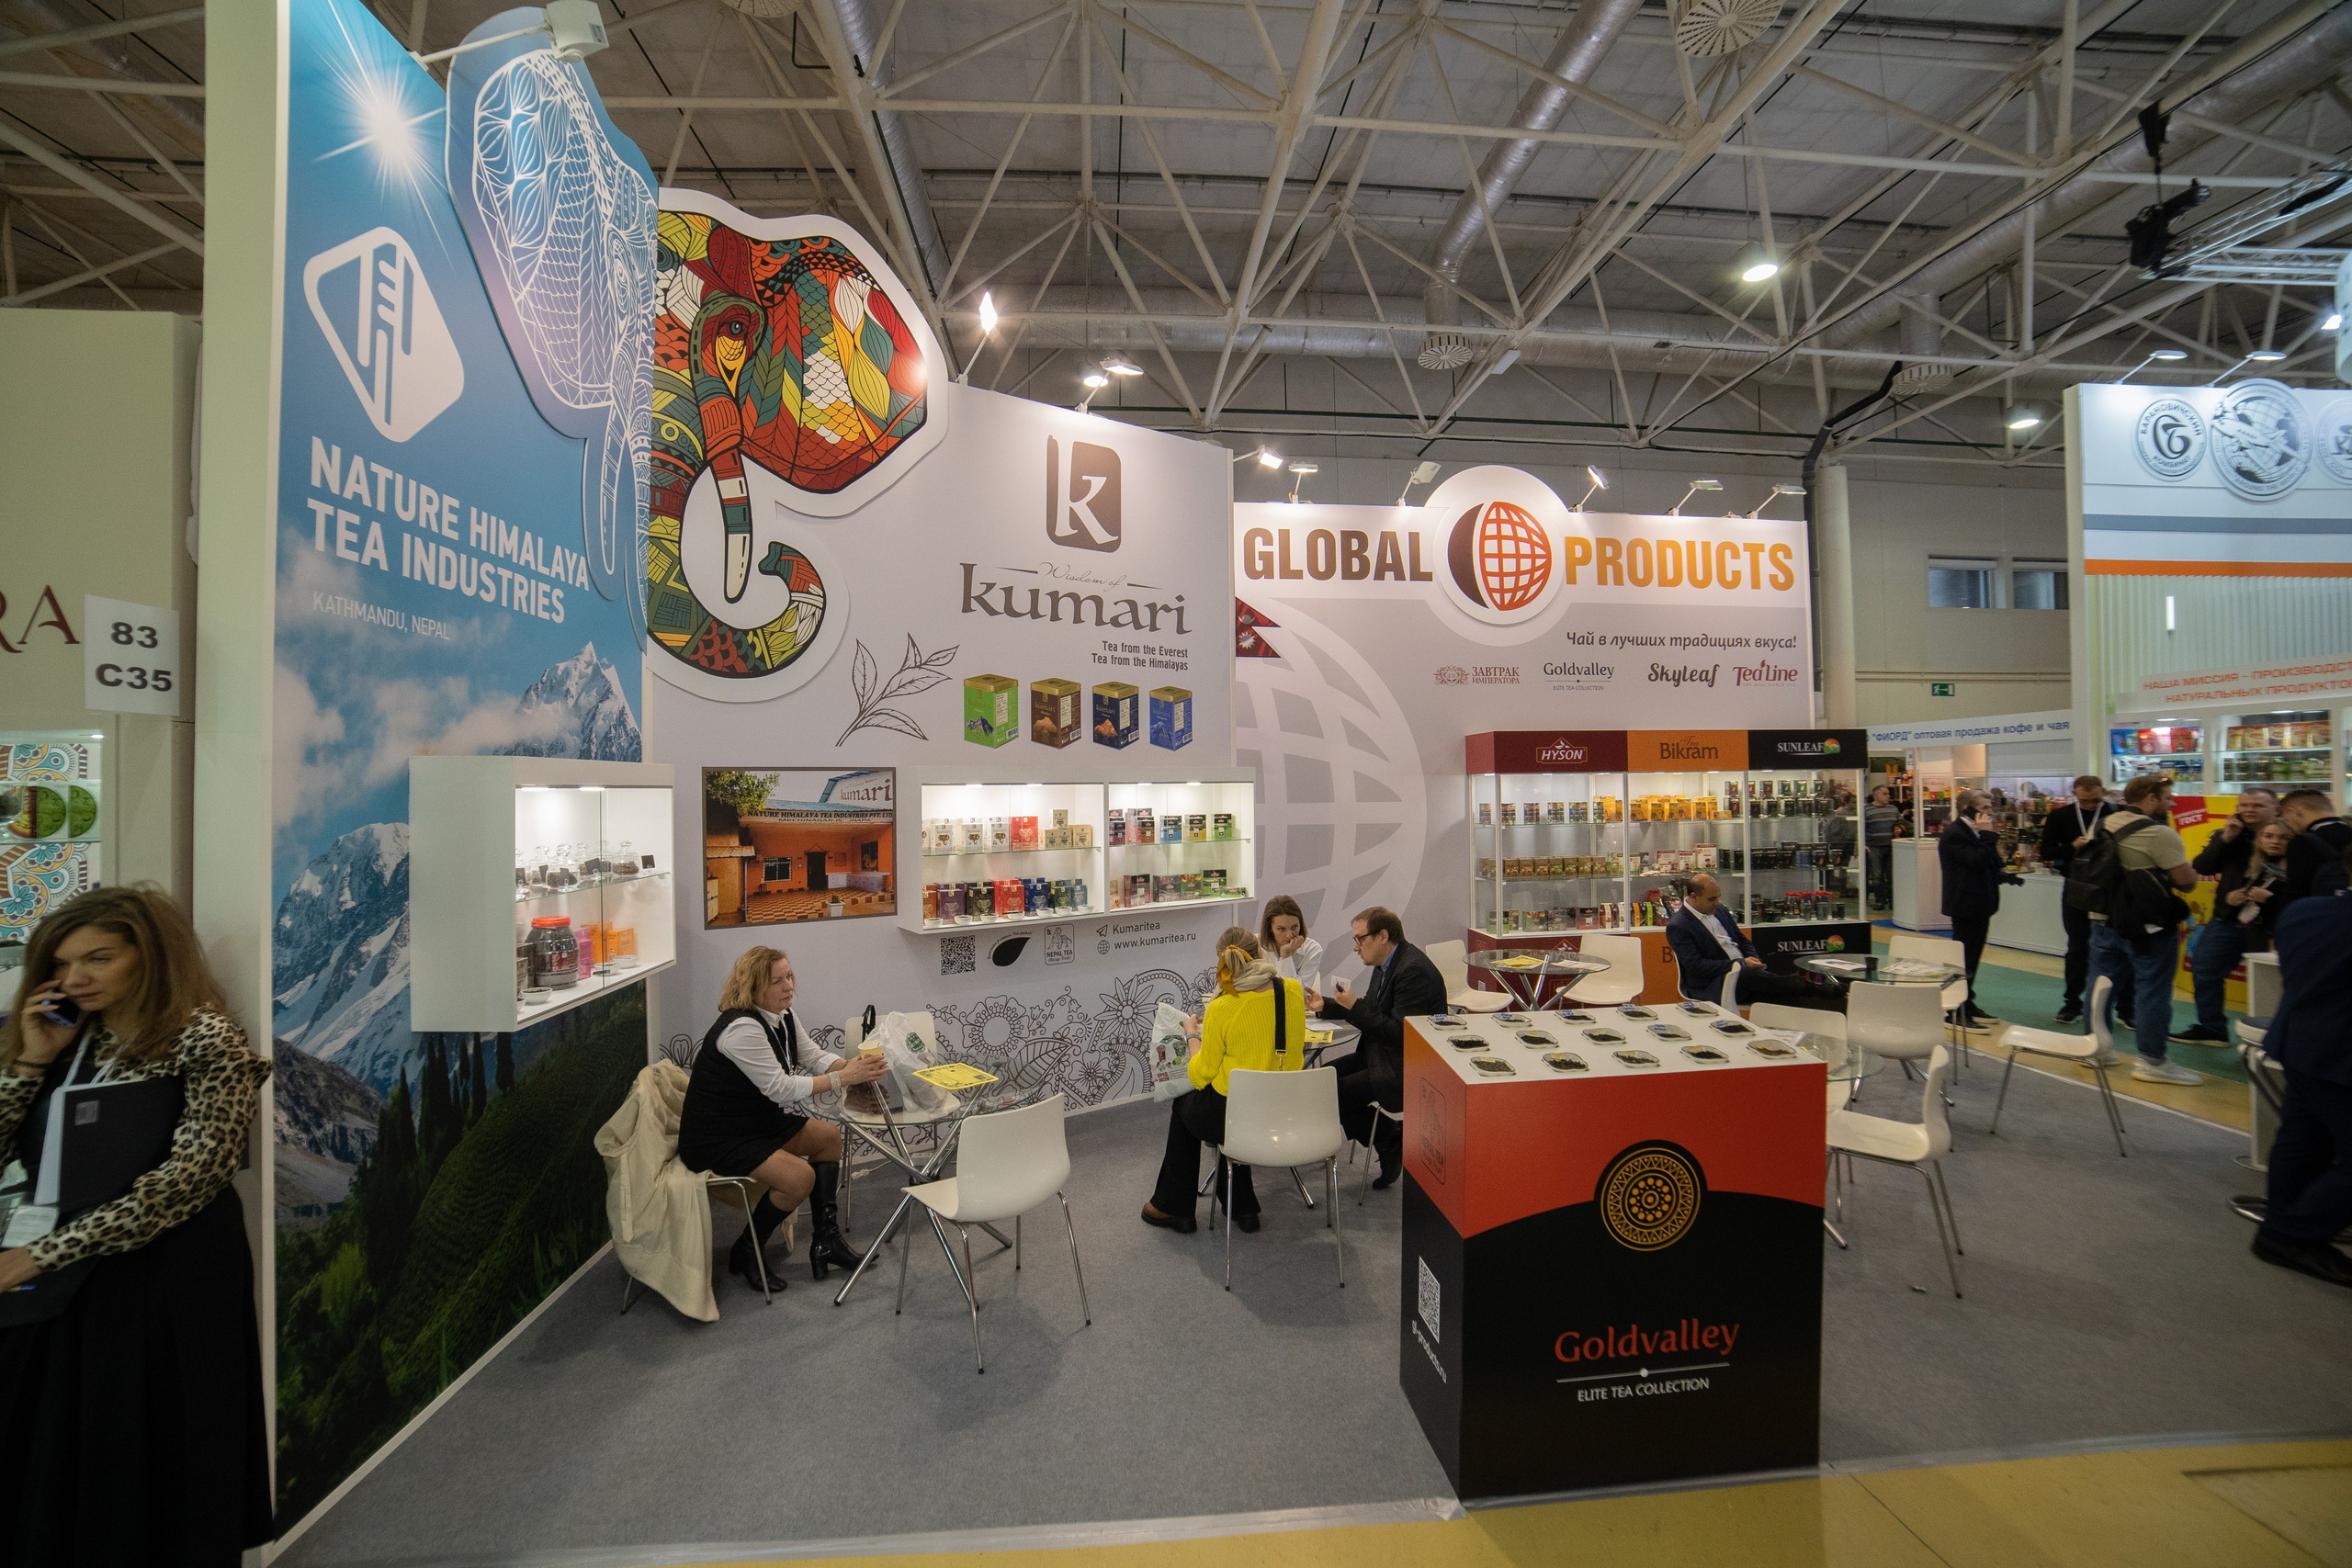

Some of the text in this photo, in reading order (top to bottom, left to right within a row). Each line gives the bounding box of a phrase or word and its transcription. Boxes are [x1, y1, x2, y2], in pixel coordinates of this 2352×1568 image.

[311, 436, 590, 591] NATURE HIMALAYA
[307, 498, 564, 624] TEA INDUSTRIES
[1243, 527, 1433, 582] GLOBAL
[1565, 536, 1794, 592] PRODUCTS
[1039, 562, 1127, 592] Wisdom of
[959, 563, 1193, 635] kumari
[313, 592, 450, 641] KATHMANDU, NEPAL
[110, 621, 158, 649] 83
[1566, 631, 1797, 651] Чай в лучших традициях вкуса!
[1102, 640, 1188, 658] Tea from the Everest
[1091, 653, 1188, 671] Tea from the Himalayas
[1472, 666, 1520, 677] ЗАВТРАК
[1544, 661, 1614, 680] Goldvalley
[1647, 662, 1721, 688] Skyleaf
[2143, 679, 2179, 690] НАША
[2182, 672, 2239, 686] МИССИЯ
[2165, 687, 2263, 703] НАТУРАЛЬНЫХ
[1914, 728, 1951, 740] оптовая
[1954, 726, 2000, 739] продажа
[2003, 722, 2033, 735] кофе
[2036, 723, 2044, 731] и
[2047, 720, 2070, 730] чая
[1541, 750, 1583, 761] HYSON
[1659, 742, 1719, 760] Bikram
[1777, 742, 1824, 752] SUNLEAF
[840, 778, 893, 802] kumari
[1113, 922, 1160, 935] Kumaritea
[1114, 932, 1196, 950] www.kumaritea.ru
[1777, 939, 1827, 953] SUNLEAF
[1555, 1318, 1740, 1363] Goldvalley
[1577, 1378, 1711, 1403] ELITE TEA COLLECTION
